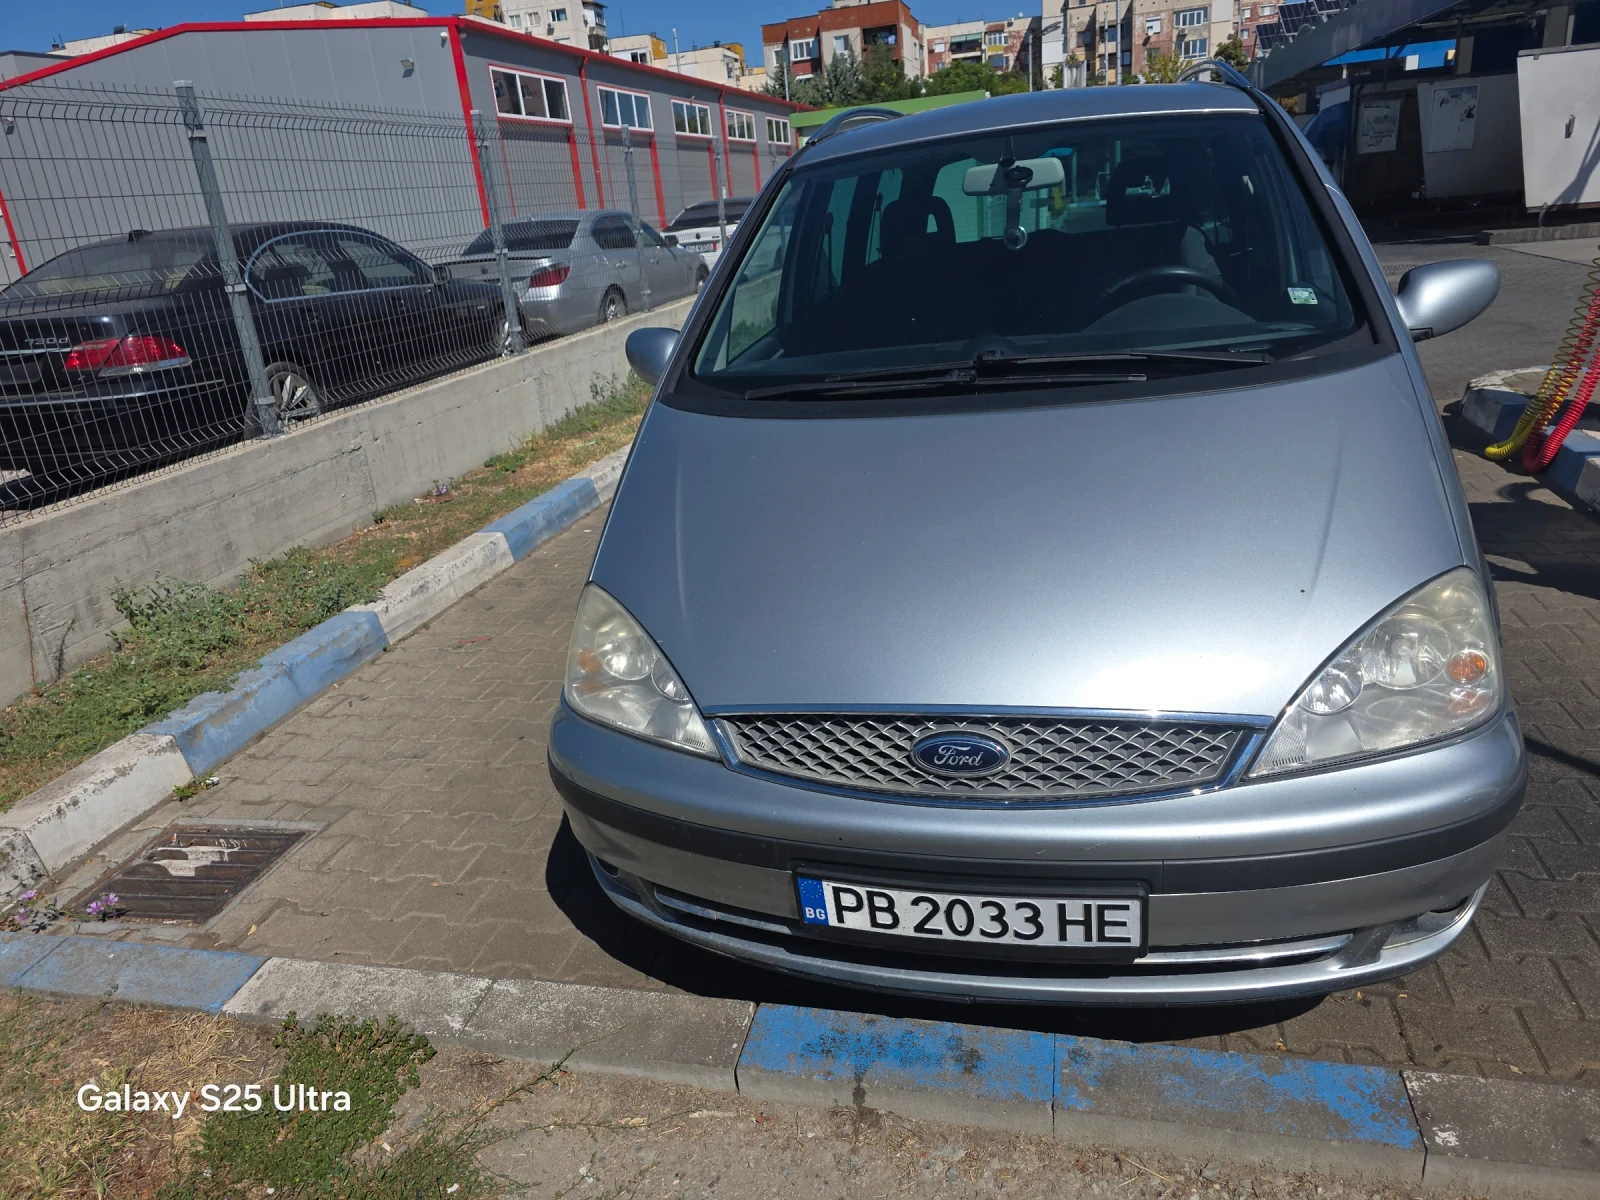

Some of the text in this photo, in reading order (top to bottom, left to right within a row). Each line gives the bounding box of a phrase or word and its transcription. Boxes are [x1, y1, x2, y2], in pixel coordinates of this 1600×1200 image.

[24, 336, 69, 346] 730d
[933, 744, 984, 766] Ford
[805, 906, 826, 920] BG
[831, 885, 1132, 943] PB 2033 HE
